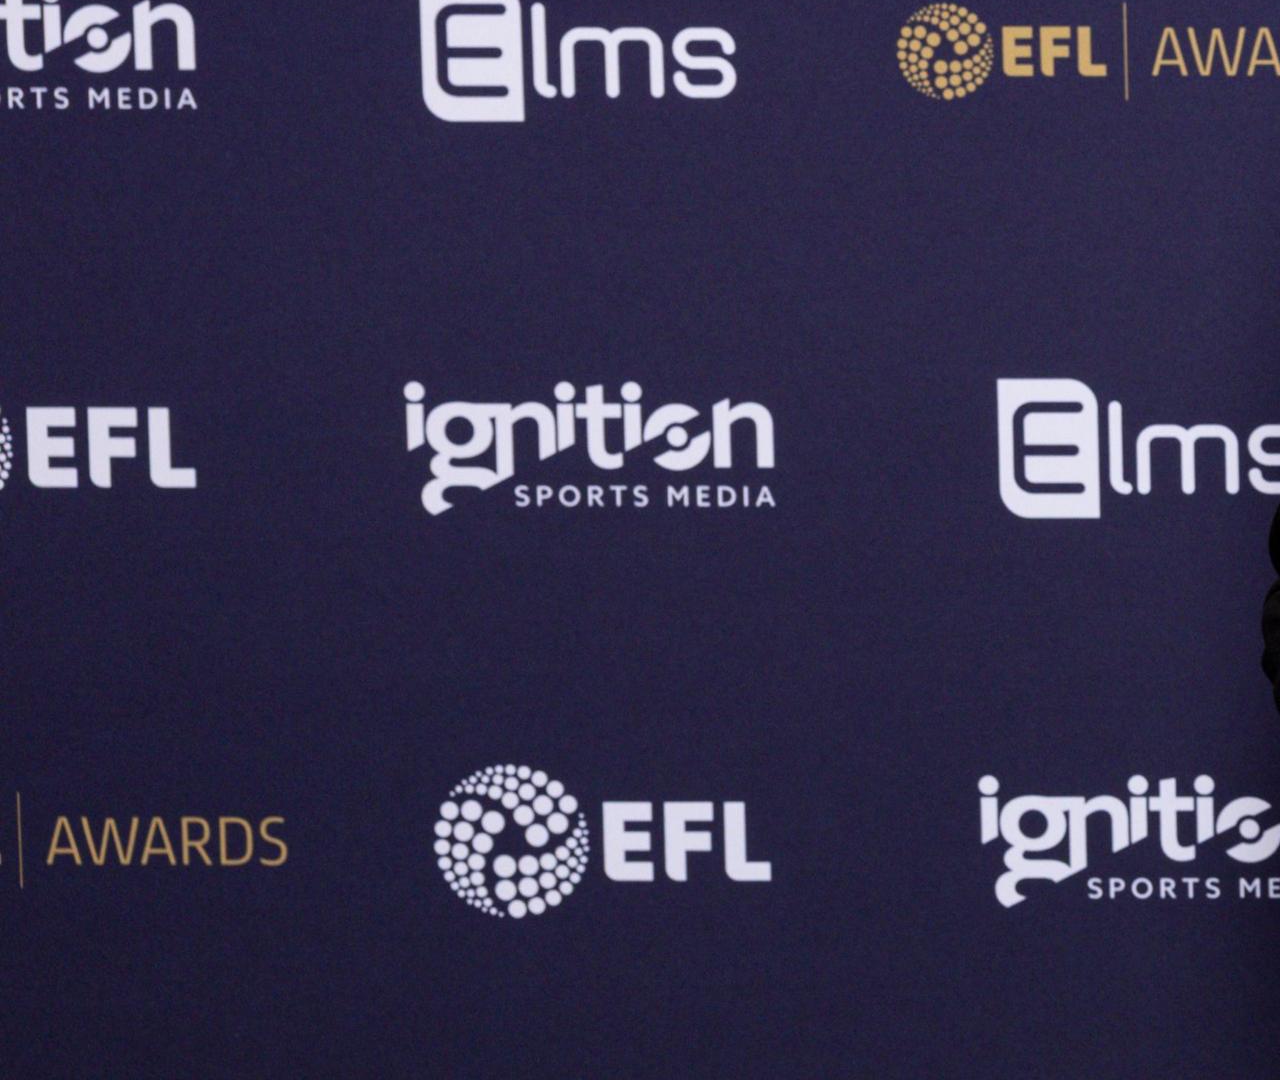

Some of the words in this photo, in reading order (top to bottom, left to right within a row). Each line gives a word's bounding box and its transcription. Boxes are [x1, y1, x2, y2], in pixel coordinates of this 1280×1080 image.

[1001, 25, 1108, 77] EFL
[0, 87, 70, 110] RTS
[88, 87, 198, 110] MEDIA
[26, 407, 197, 488] EFL
[403, 381, 775, 515] ignition
[514, 485, 649, 507] SPORTS
[667, 485, 776, 507] MEDIA
[46, 815, 289, 866] AWARDS
[602, 801, 772, 881] EFL
[1087, 877, 1221, 899] SPORTS
